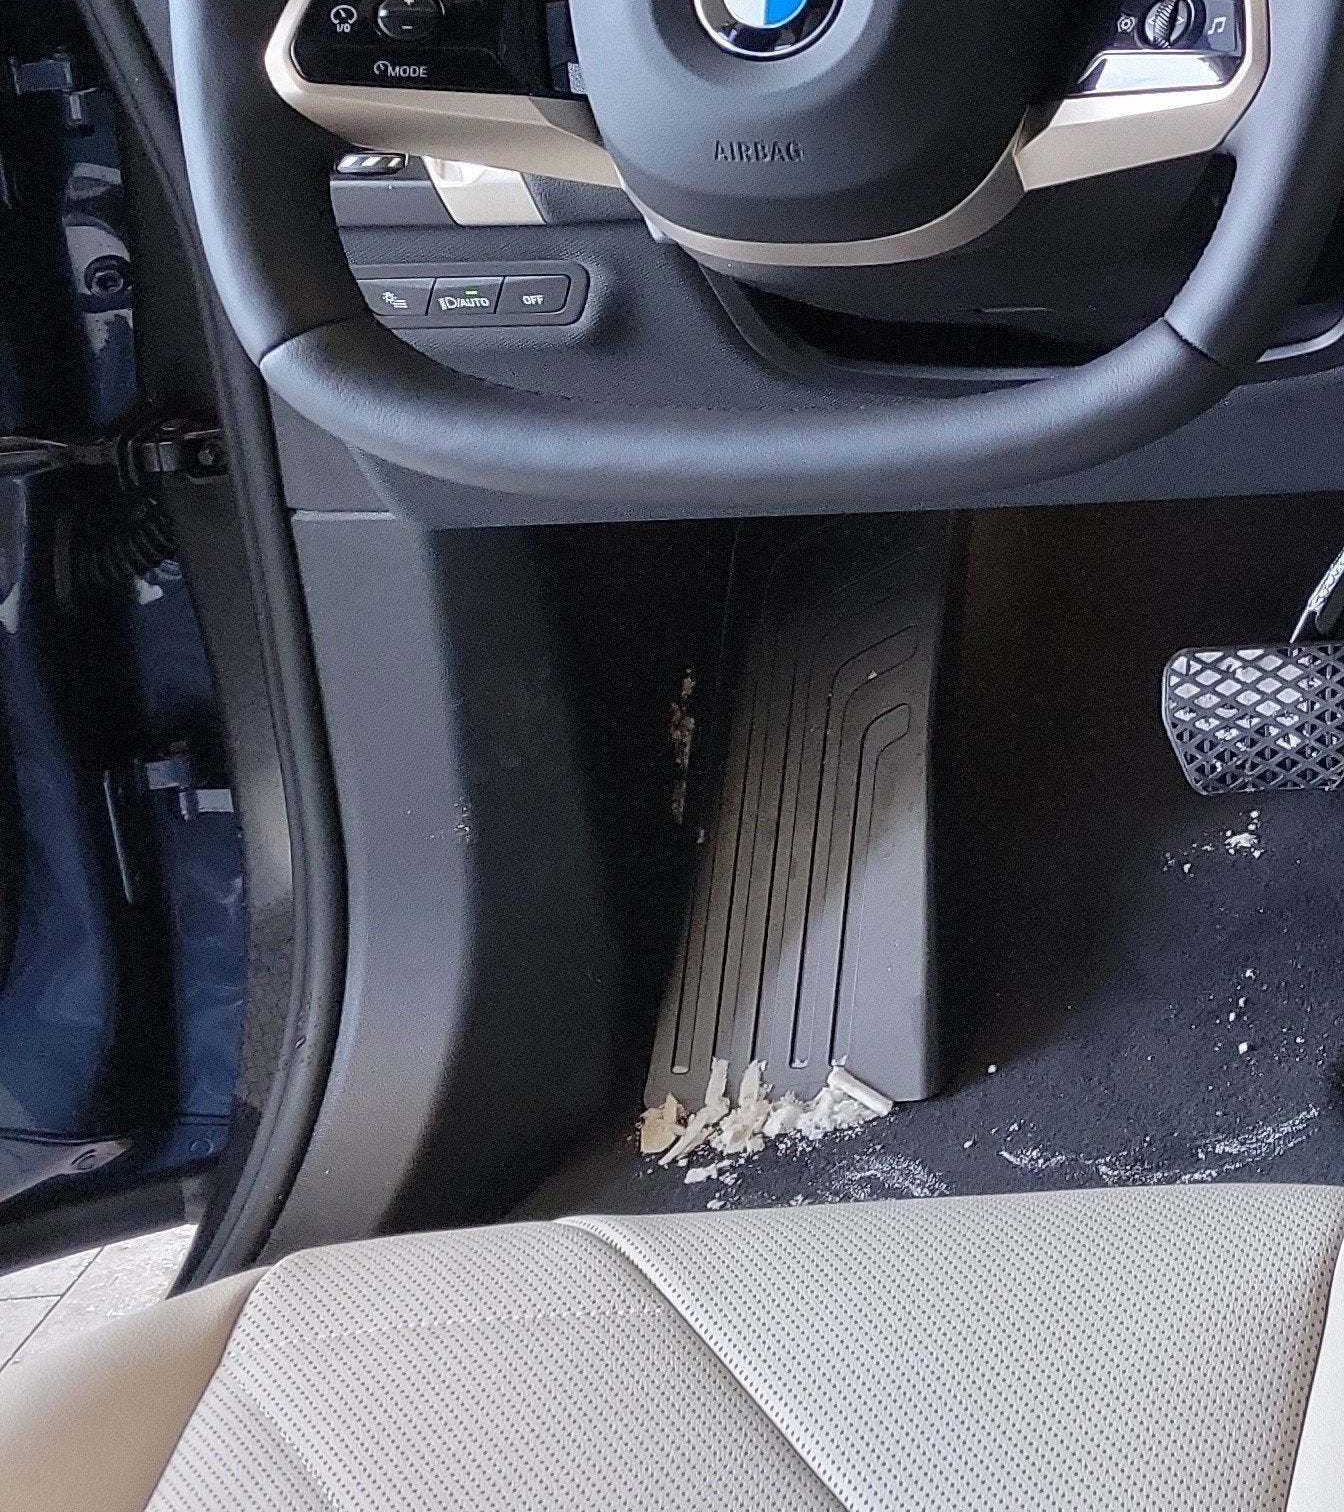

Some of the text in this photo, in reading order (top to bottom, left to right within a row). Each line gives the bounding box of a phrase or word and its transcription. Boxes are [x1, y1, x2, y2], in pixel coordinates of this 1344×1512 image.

[388, 65, 429, 78] MODE
[713, 140, 804, 163] AIRBAG
[522, 294, 544, 306] OFF
